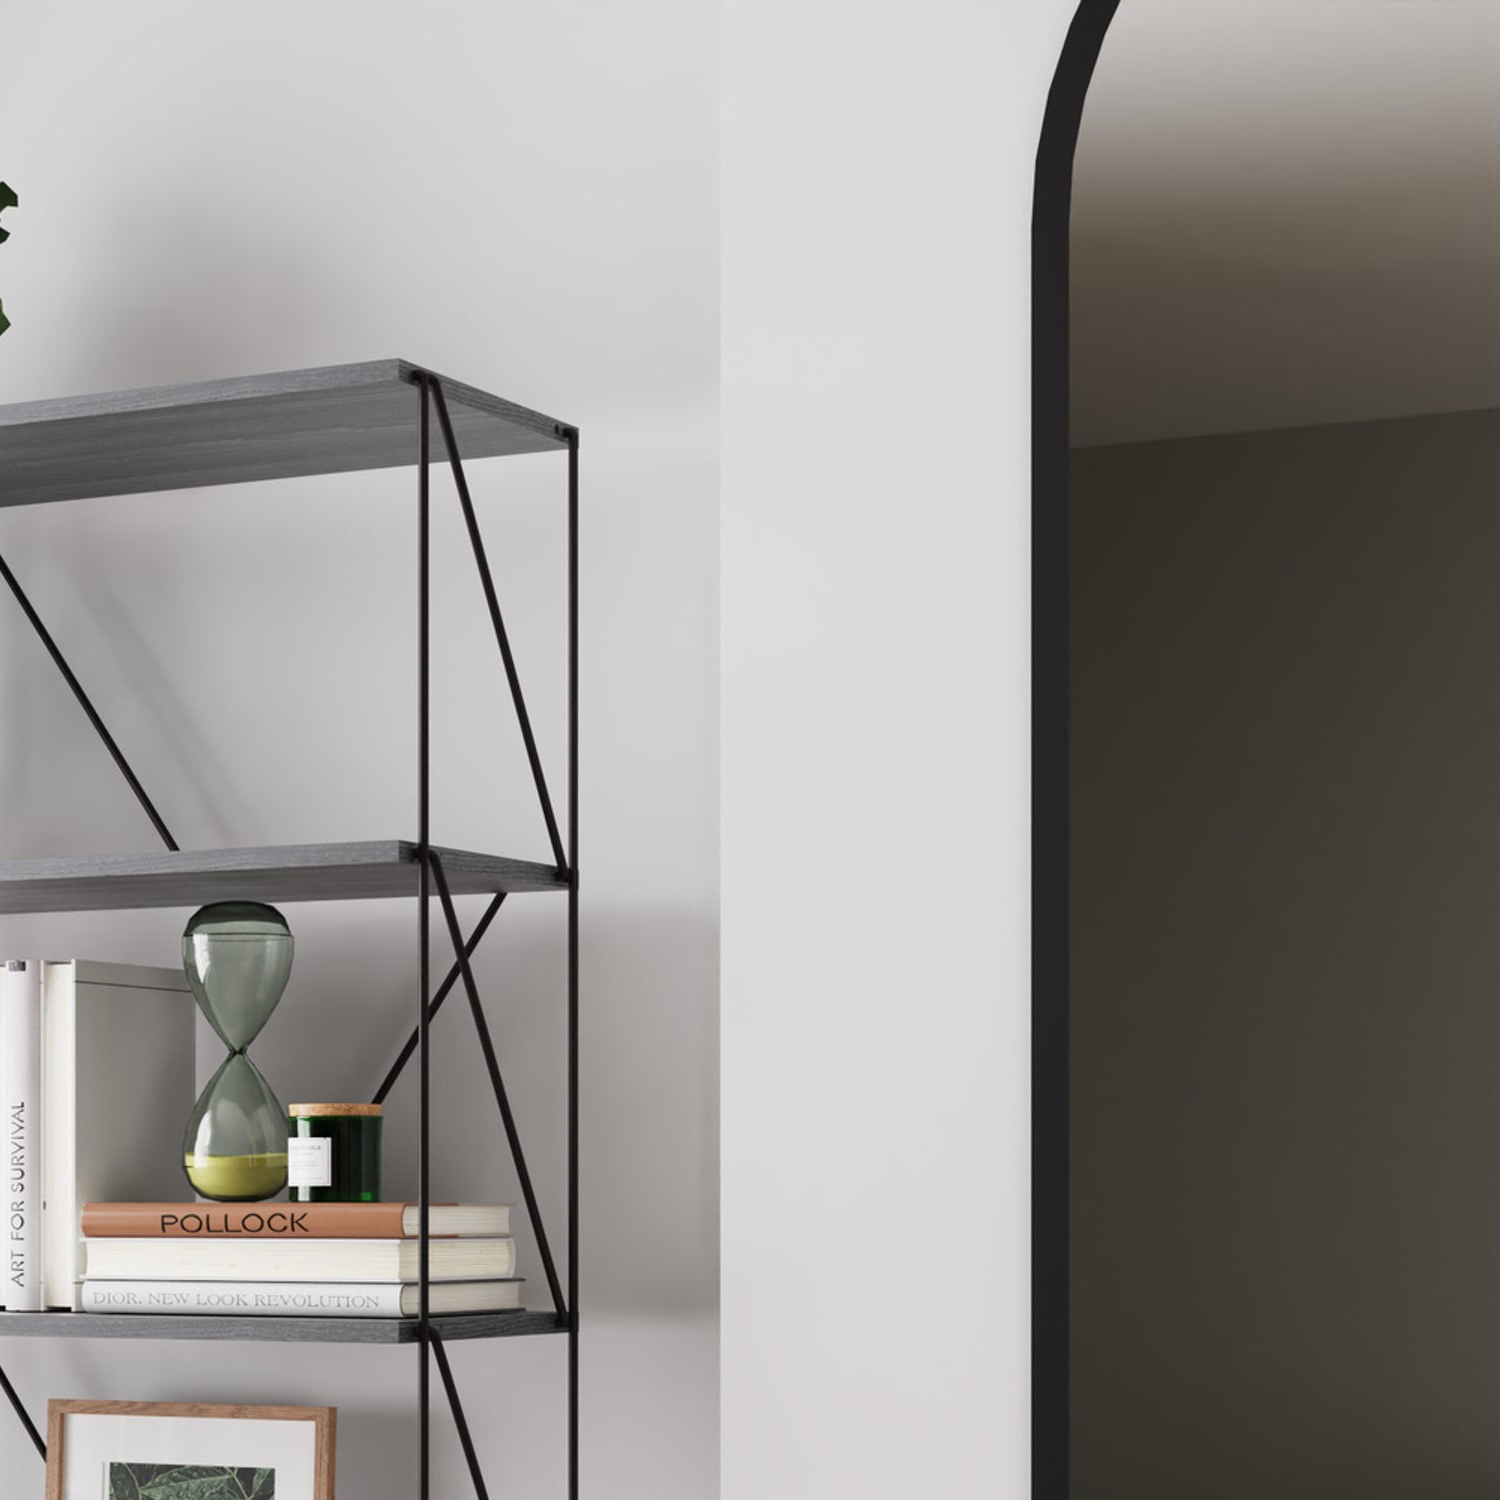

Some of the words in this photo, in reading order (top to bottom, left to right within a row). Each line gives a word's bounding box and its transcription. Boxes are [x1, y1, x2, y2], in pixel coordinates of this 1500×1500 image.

[10, 1101, 25, 1193] SURVIVAL
[10, 1200, 25, 1241] FOR
[160, 1212, 310, 1233] POLLOCK
[10, 1250, 25, 1287] ART
[148, 1292, 190, 1305] NEW
[196, 1293, 248, 1306] LOOK
[254, 1294, 380, 1308] REVOLUTION
